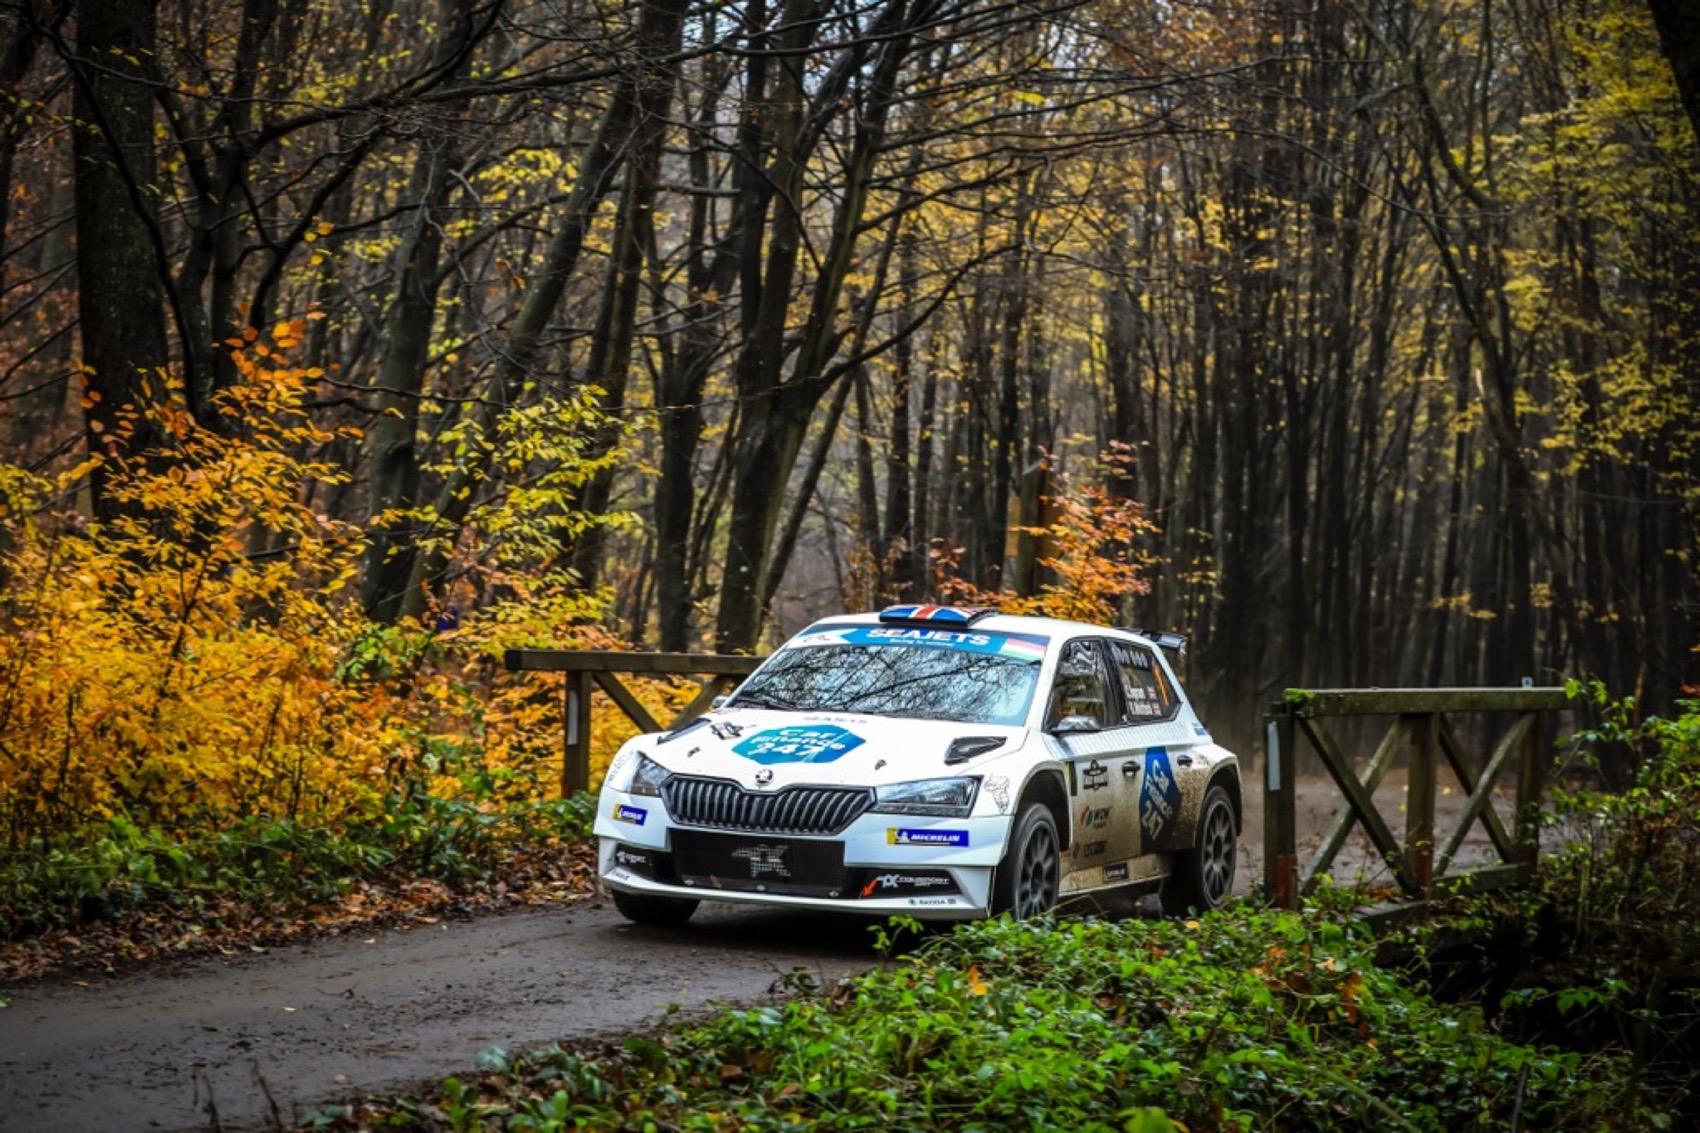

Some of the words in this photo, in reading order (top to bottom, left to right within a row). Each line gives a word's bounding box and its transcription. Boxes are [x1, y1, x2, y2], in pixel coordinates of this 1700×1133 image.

[866, 628, 991, 646] SEAJETS
[779, 729, 837, 739] Car
[747, 742, 826, 757] 247
[911, 834, 960, 842] MICHELIN
